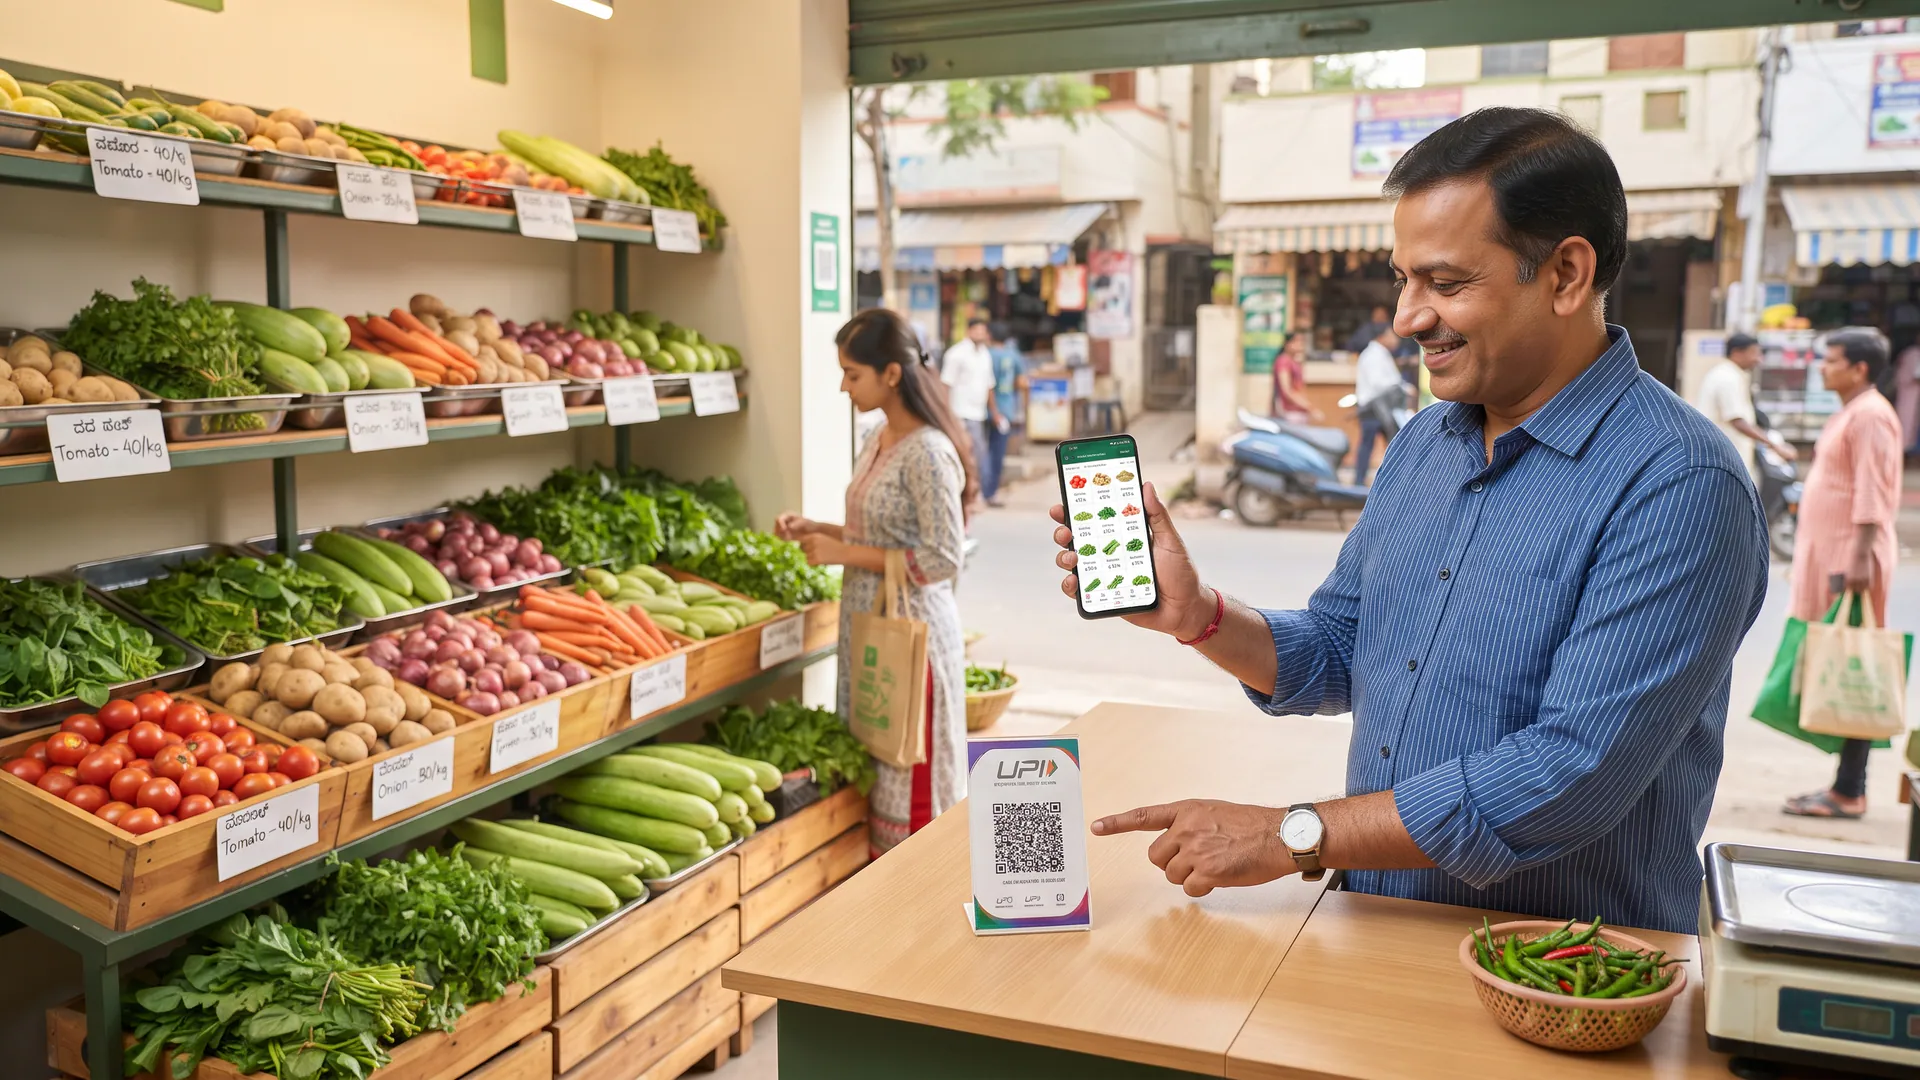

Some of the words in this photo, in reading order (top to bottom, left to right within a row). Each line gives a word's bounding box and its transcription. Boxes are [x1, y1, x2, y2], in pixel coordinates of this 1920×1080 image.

[94, 159, 144, 179] Tomato
[156, 168, 193, 191] 40/kg
[54, 443, 110, 462] Tomato
[122, 435, 163, 458] 40/kg
[997, 759, 1046, 779] UPI
[378, 780, 408, 799] Onion
[221, 828, 266, 856] Tomato
[278, 809, 312, 833] 40/kg
